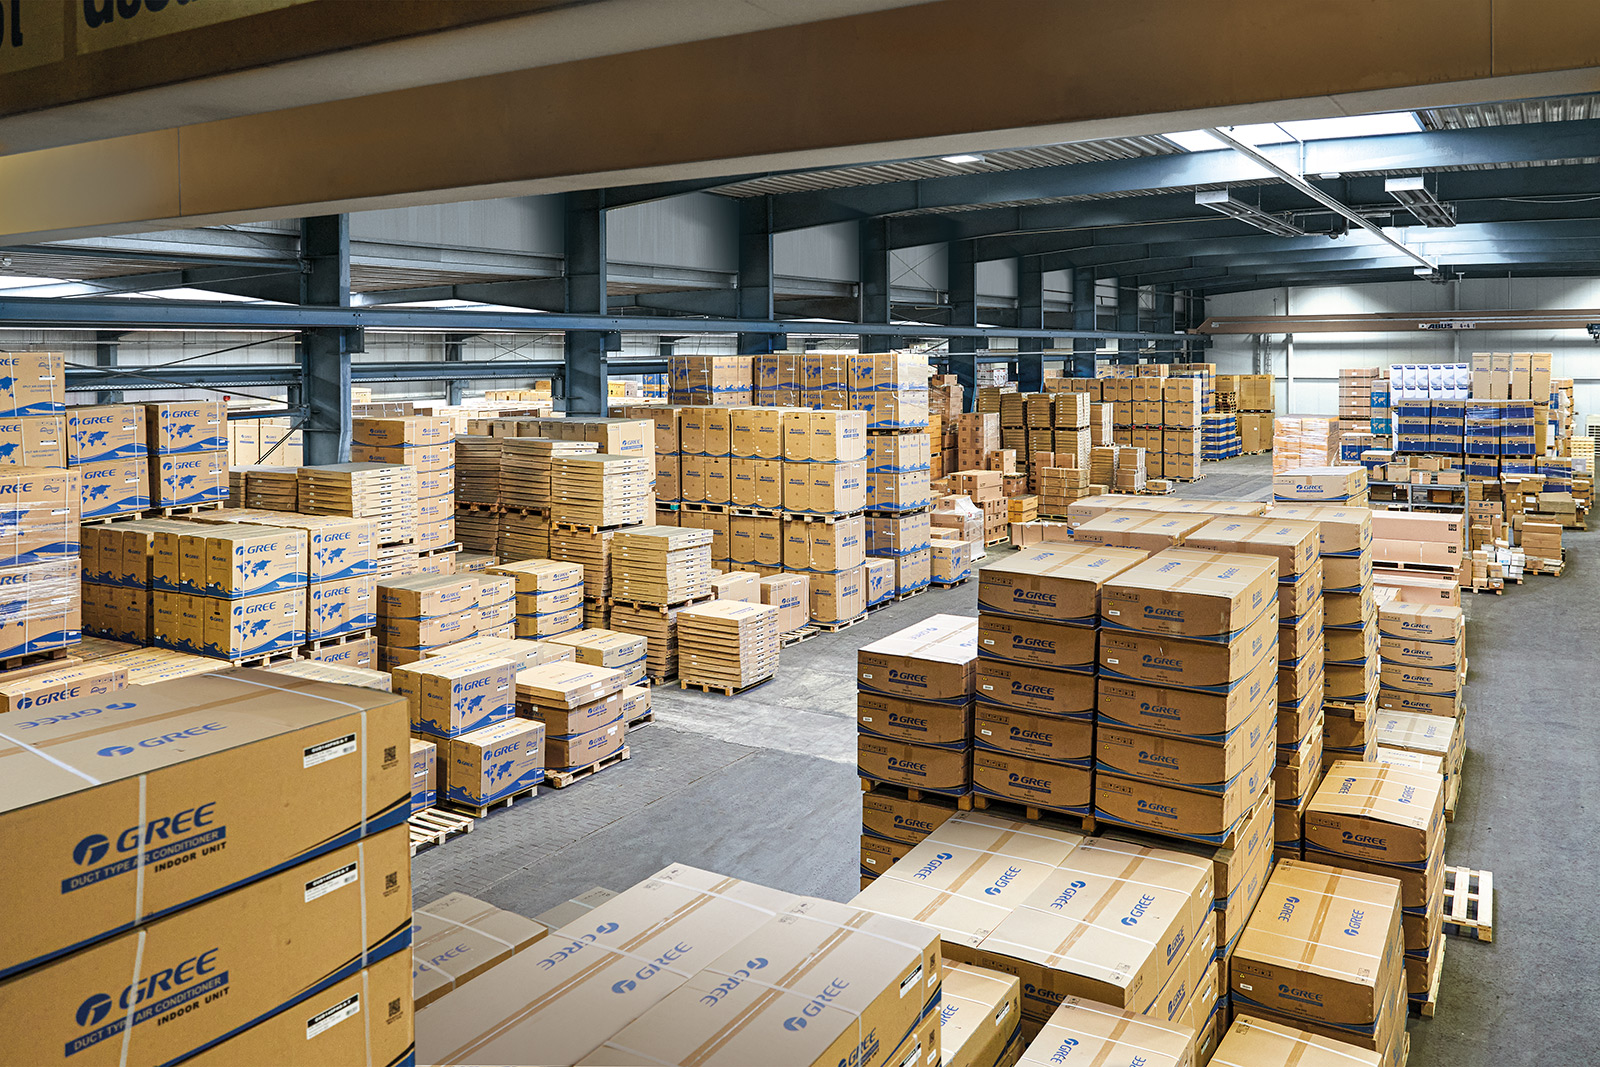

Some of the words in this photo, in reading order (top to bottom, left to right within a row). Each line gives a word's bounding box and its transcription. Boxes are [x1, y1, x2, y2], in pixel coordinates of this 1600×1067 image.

[0, 358, 20, 366] REE
[82, 415, 114, 425] GREE
[172, 410, 200, 419] GREE
[0, 425, 21, 433] REE
[175, 460, 201, 469] GREE
[84, 469, 117, 479] GREE
[324, 532, 351, 542] GREE
[247, 542, 278, 554] GREE
[0, 572, 32, 585] REE
[324, 586, 351, 598] GREE
[1026, 591, 1057, 602] GREE
[246, 601, 277, 615] GREE
[1155, 608, 1184, 618] GREE
[1025, 637, 1056, 649] GREE
[324, 650, 351, 663] GREE
[1153, 656, 1183, 666] GREE
[464, 677, 490, 691] GREE
[900, 672, 927, 683] GREE
[1023, 684, 1055, 695] GREE
[36, 687, 80, 706] GREE
[1151, 705, 1180, 716] GREE
[14, 708, 102, 729] GREE
[900, 715, 927, 726] GREE
[138, 722, 228, 748] GREE
[1022, 730, 1053, 741] GREE
[494, 741, 520, 758] GREE
[899, 760, 927, 770] GREE
[1150, 753, 1179, 765] GREE
[1020, 776, 1051, 788] GREE
[1148, 802, 1178, 814] GREE
[116, 801, 216, 853] GREE
[904, 818, 934, 830] GREE
[1355, 834, 1387, 846] GREE
[71, 871, 101, 889] DUCT
[103, 858, 131, 878] TYPE
[152, 830, 220, 860] CONDITIONER
[154, 852, 197, 873] INDOOR
[201, 841, 227, 856] UNIT
[913, 859, 942, 880] GREE
[995, 866, 1021, 888] GREE
[1050, 888, 1077, 910] GREE
[1130, 894, 1155, 918] GREE
[1278, 903, 1296, 922] GREE
[1349, 909, 1364, 929] GREE
[418, 943, 471, 972] GREE
[536, 934, 597, 971] GREE
[635, 941, 693, 981] GREE
[119, 947, 218, 1010] GREE
[700, 969, 750, 1008] GREE
[1290, 988, 1323, 1001] GREE
[802, 977, 850, 1017] GREE
[73, 1030, 103, 1051] DUCT
[108, 1017, 131, 1036] TYP
[135, 1008, 153, 1022] AIR
[155, 976, 221, 1013] CONDITIONER
[157, 1001, 200, 1027] INDOOR
[204, 987, 230, 1004] UNIT
[1050, 1044, 1072, 1064] GREE
